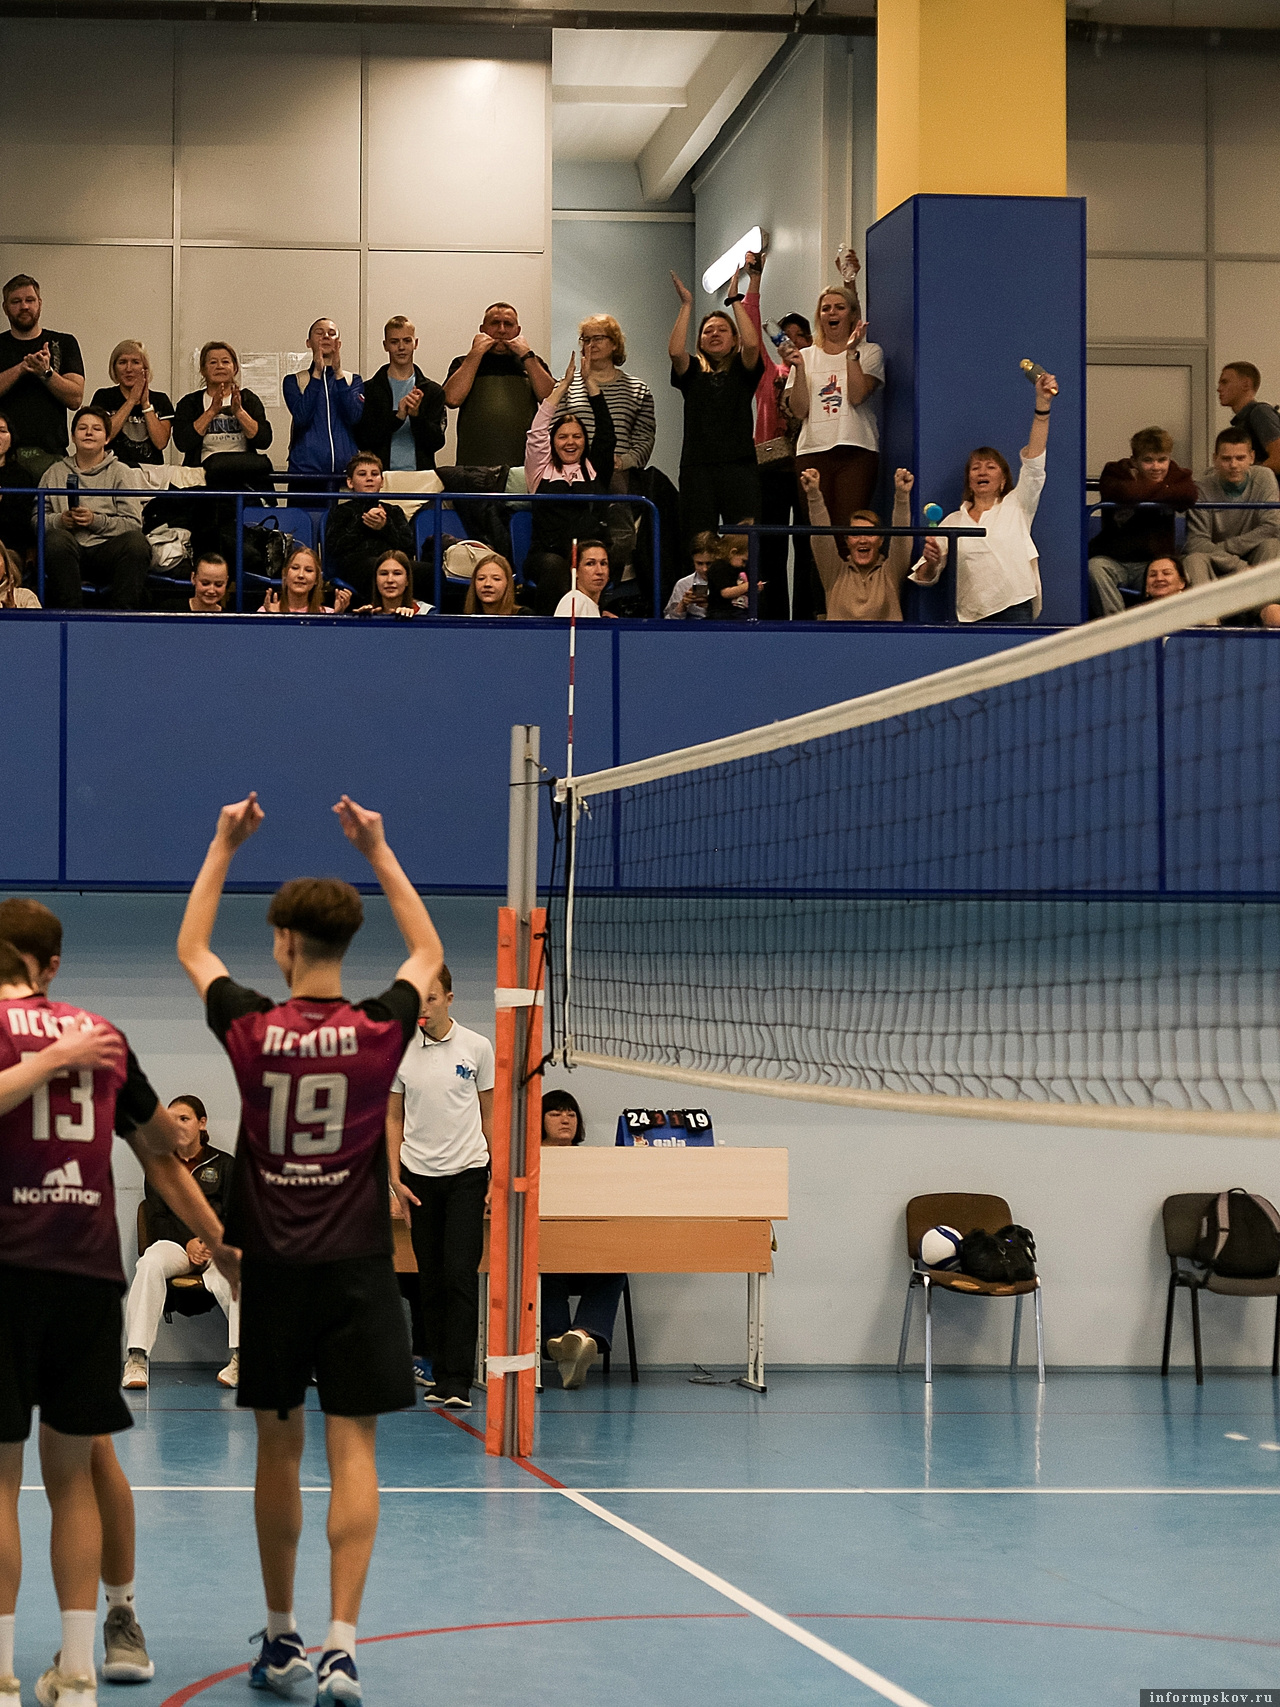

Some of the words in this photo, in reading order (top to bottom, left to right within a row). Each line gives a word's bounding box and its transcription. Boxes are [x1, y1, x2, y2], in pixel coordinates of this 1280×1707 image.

[262, 1025, 359, 1058] ПСКОВ
[21, 1052, 95, 1142] 13
[262, 1071, 349, 1156] 19
[627, 1112, 650, 1127] 24
[686, 1113, 709, 1128] 19
